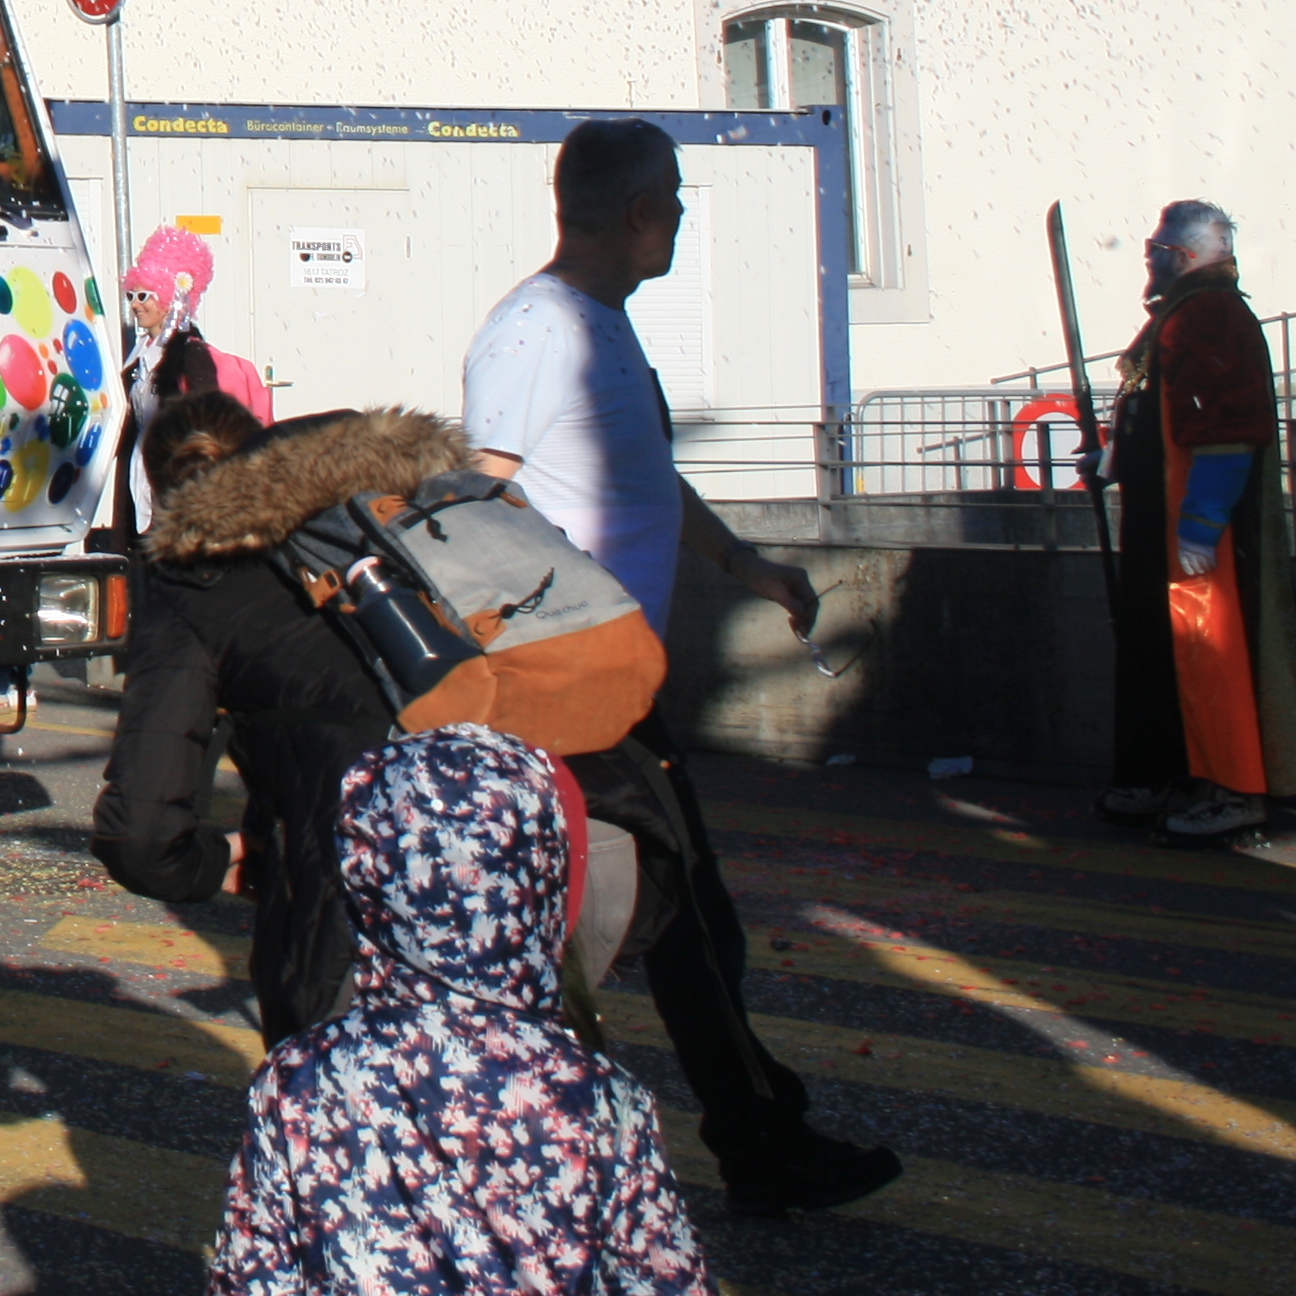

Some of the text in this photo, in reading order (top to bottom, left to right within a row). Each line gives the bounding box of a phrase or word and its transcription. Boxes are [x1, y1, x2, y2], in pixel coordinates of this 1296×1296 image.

[133, 115, 229, 134] Condecta
[246, 119, 325, 133] Bürocontainer
[427, 121, 520, 138] Condecta
[292, 241, 341, 251] TRANSPORTS
